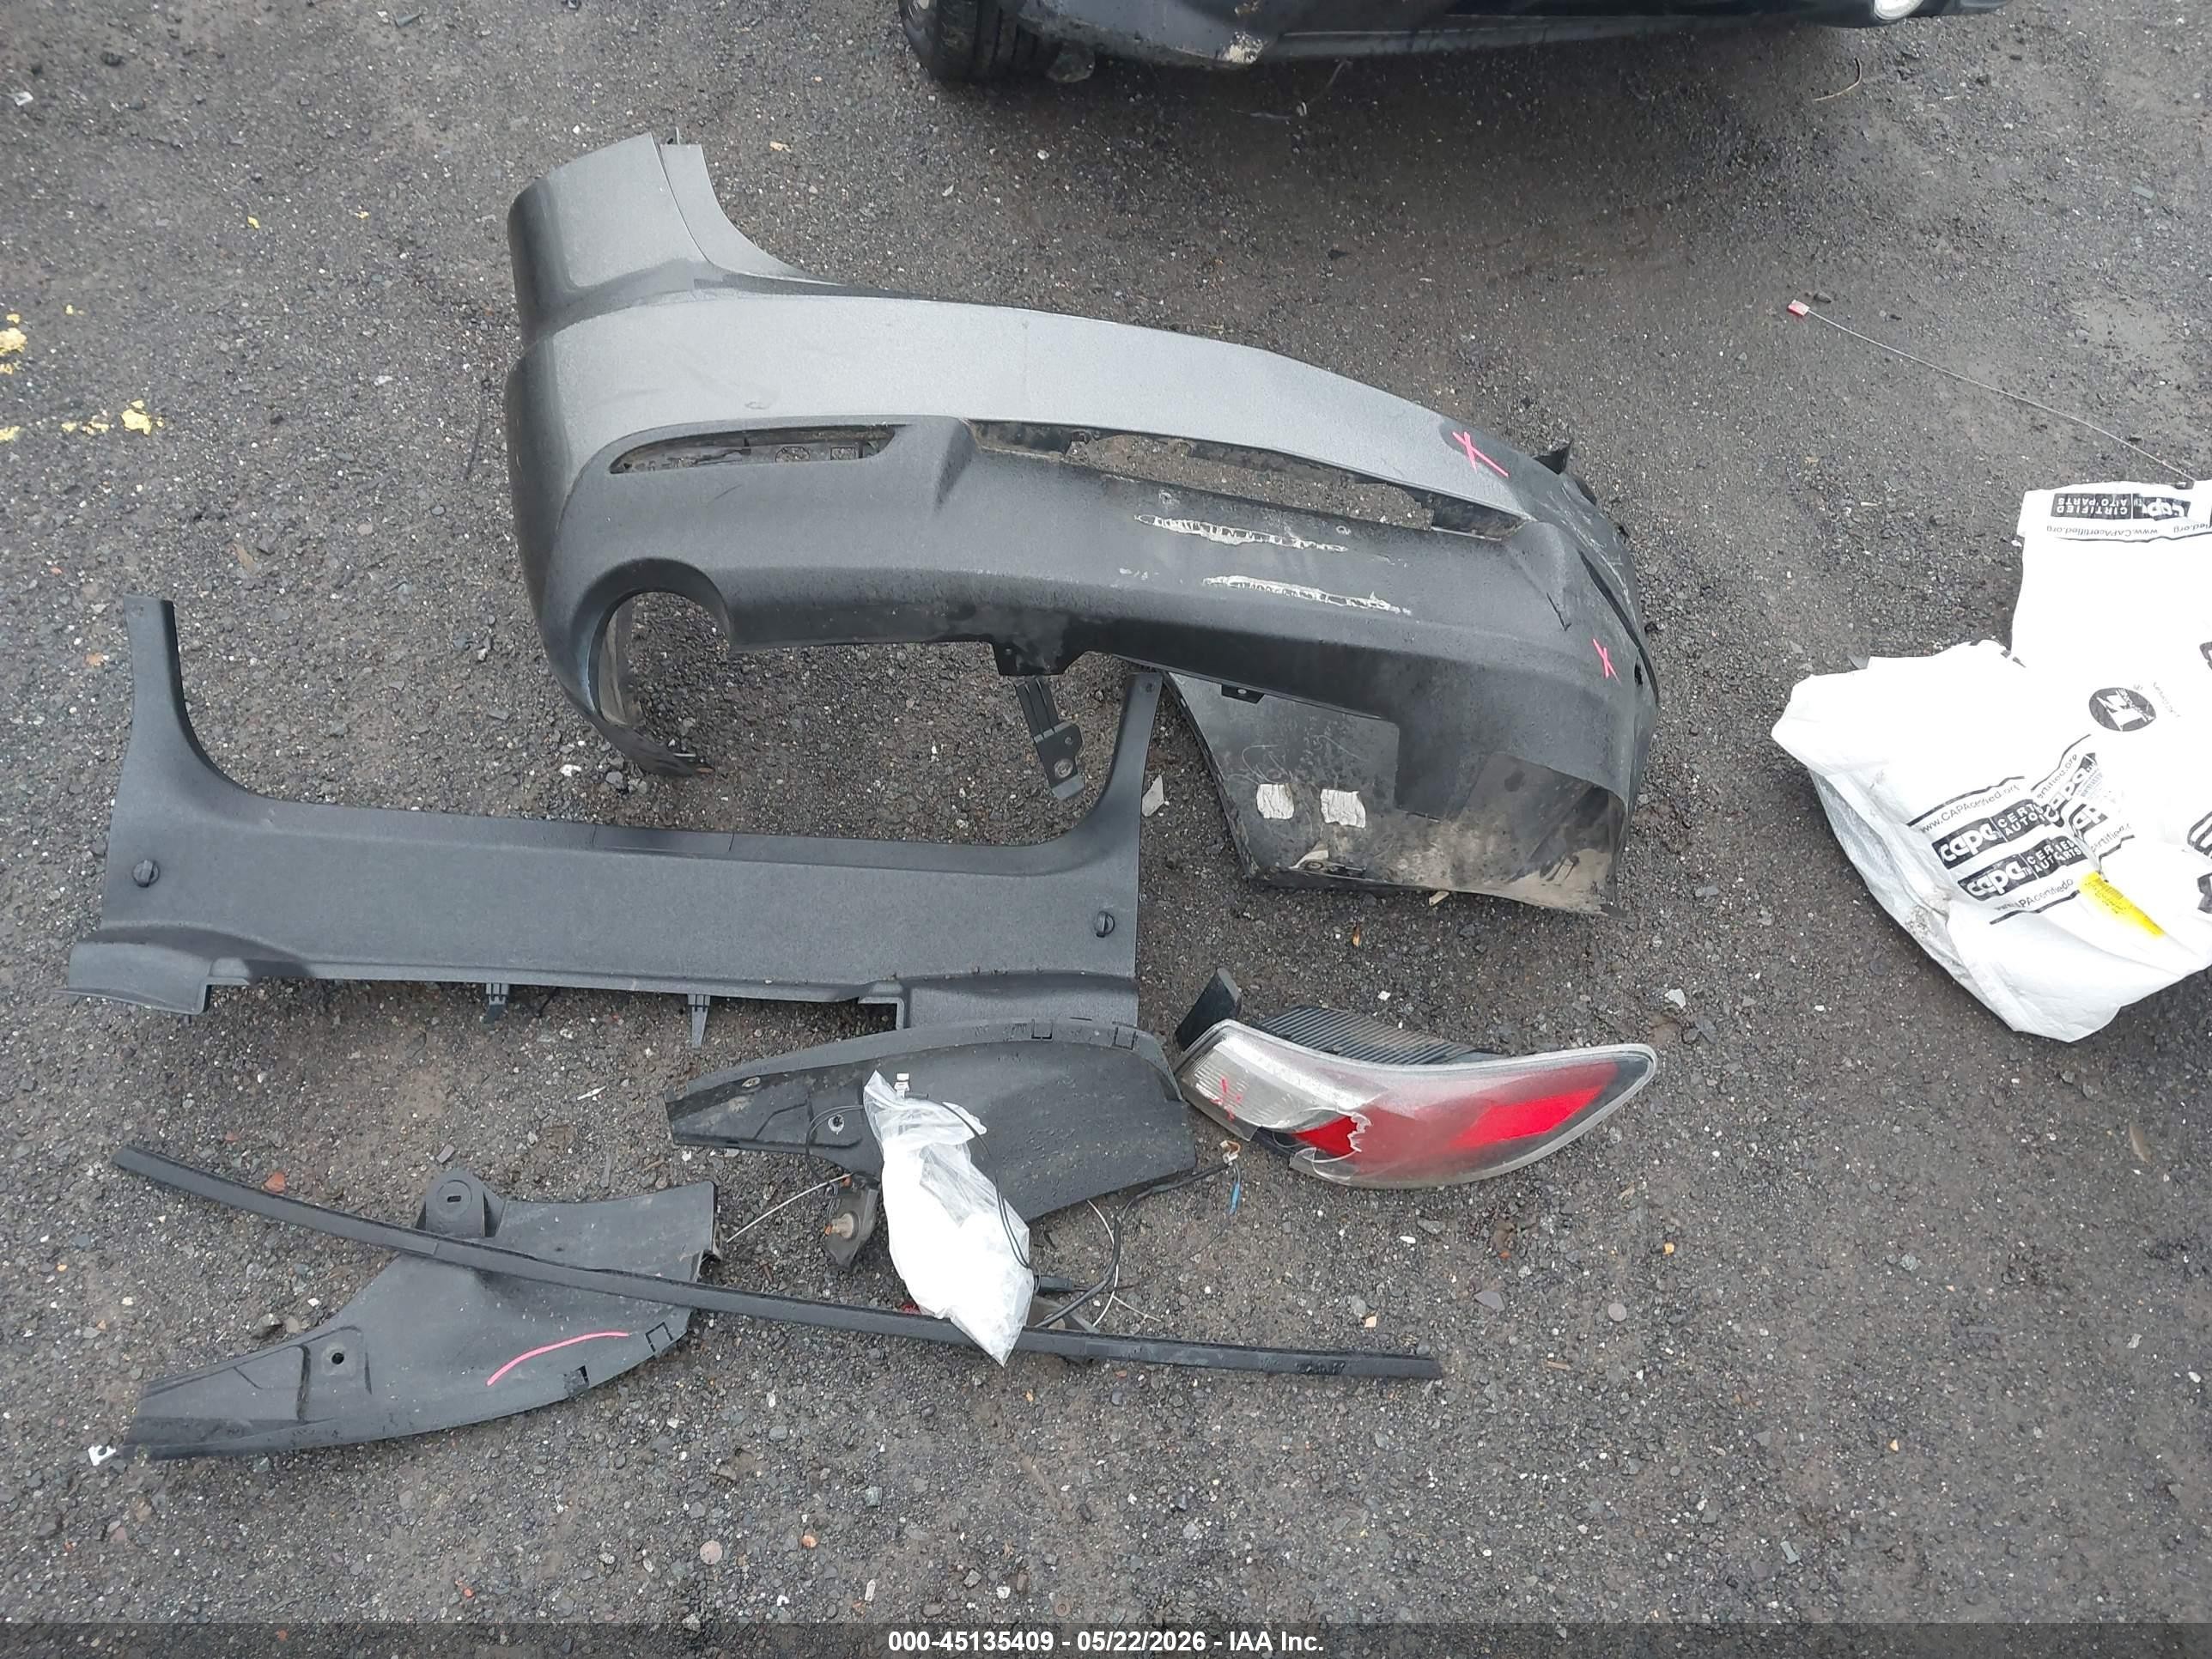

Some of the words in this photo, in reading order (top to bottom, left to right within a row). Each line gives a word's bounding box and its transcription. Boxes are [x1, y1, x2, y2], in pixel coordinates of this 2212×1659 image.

[2005, 811, 2039, 836] AUTO
[1938, 823, 1998, 861] capa
[1966, 860, 2027, 896] capa
